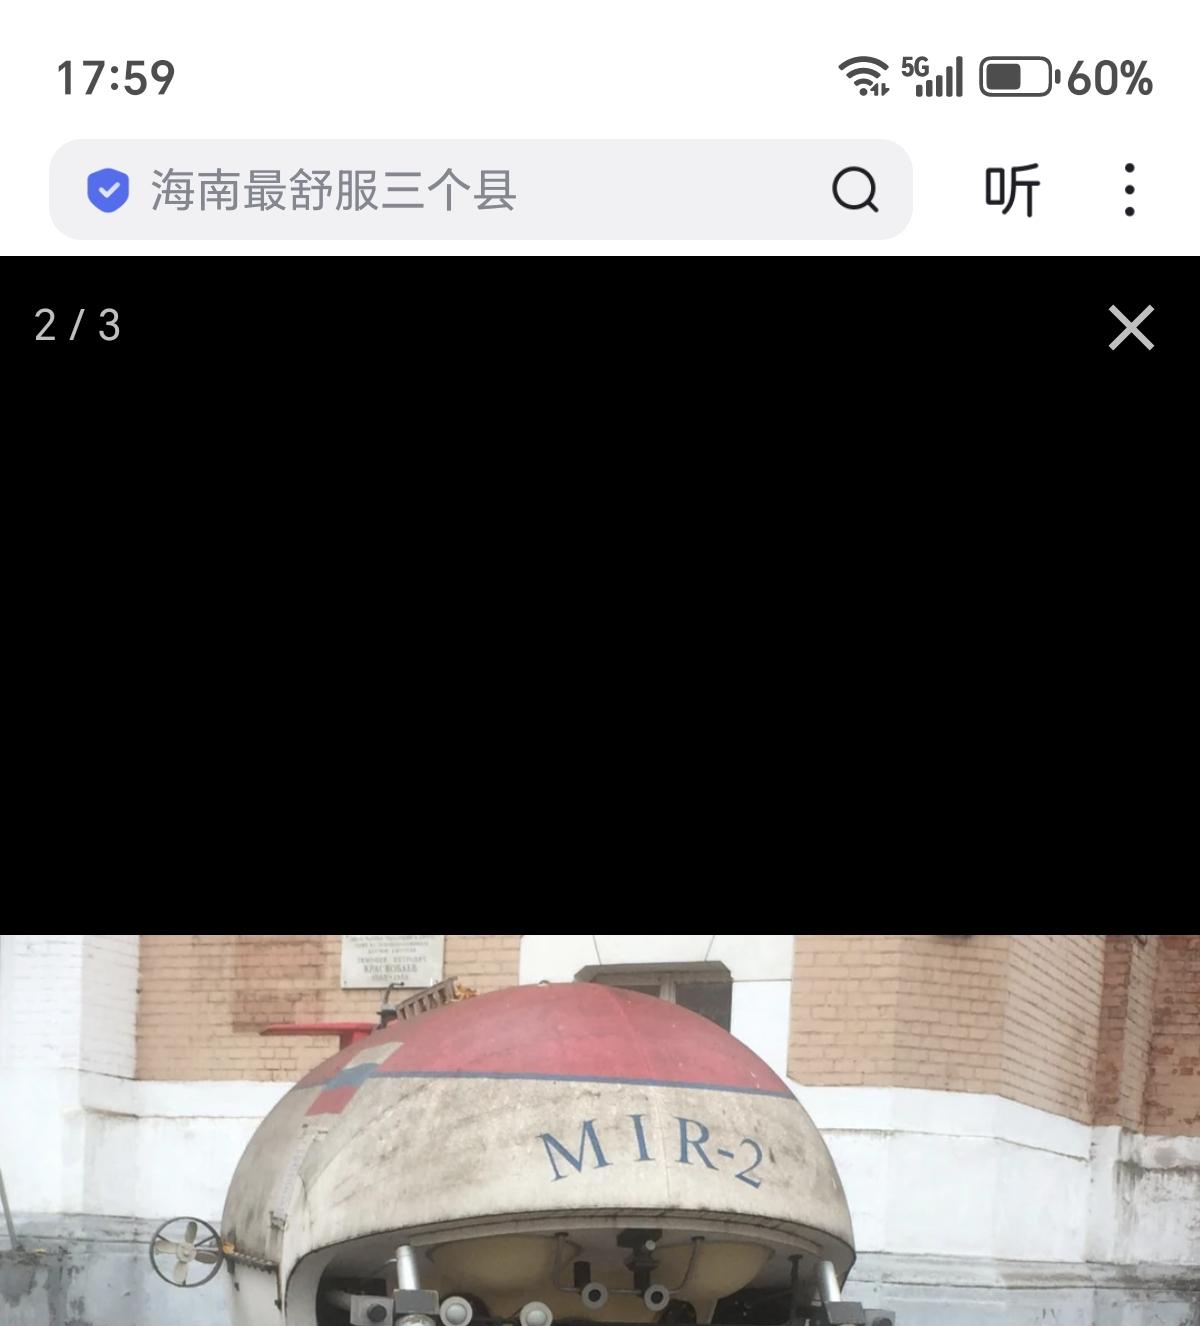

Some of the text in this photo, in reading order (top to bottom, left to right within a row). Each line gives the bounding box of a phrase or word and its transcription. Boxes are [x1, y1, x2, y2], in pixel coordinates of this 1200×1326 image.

[58, 59, 176, 97] 17:59
[901, 55, 930, 78] 5G
[1066, 59, 1155, 96] 60%
[150, 167, 518, 212] 海南最舒服三个县
[984, 162, 1042, 219] 听
[537, 1113, 764, 1190] MIR-2
